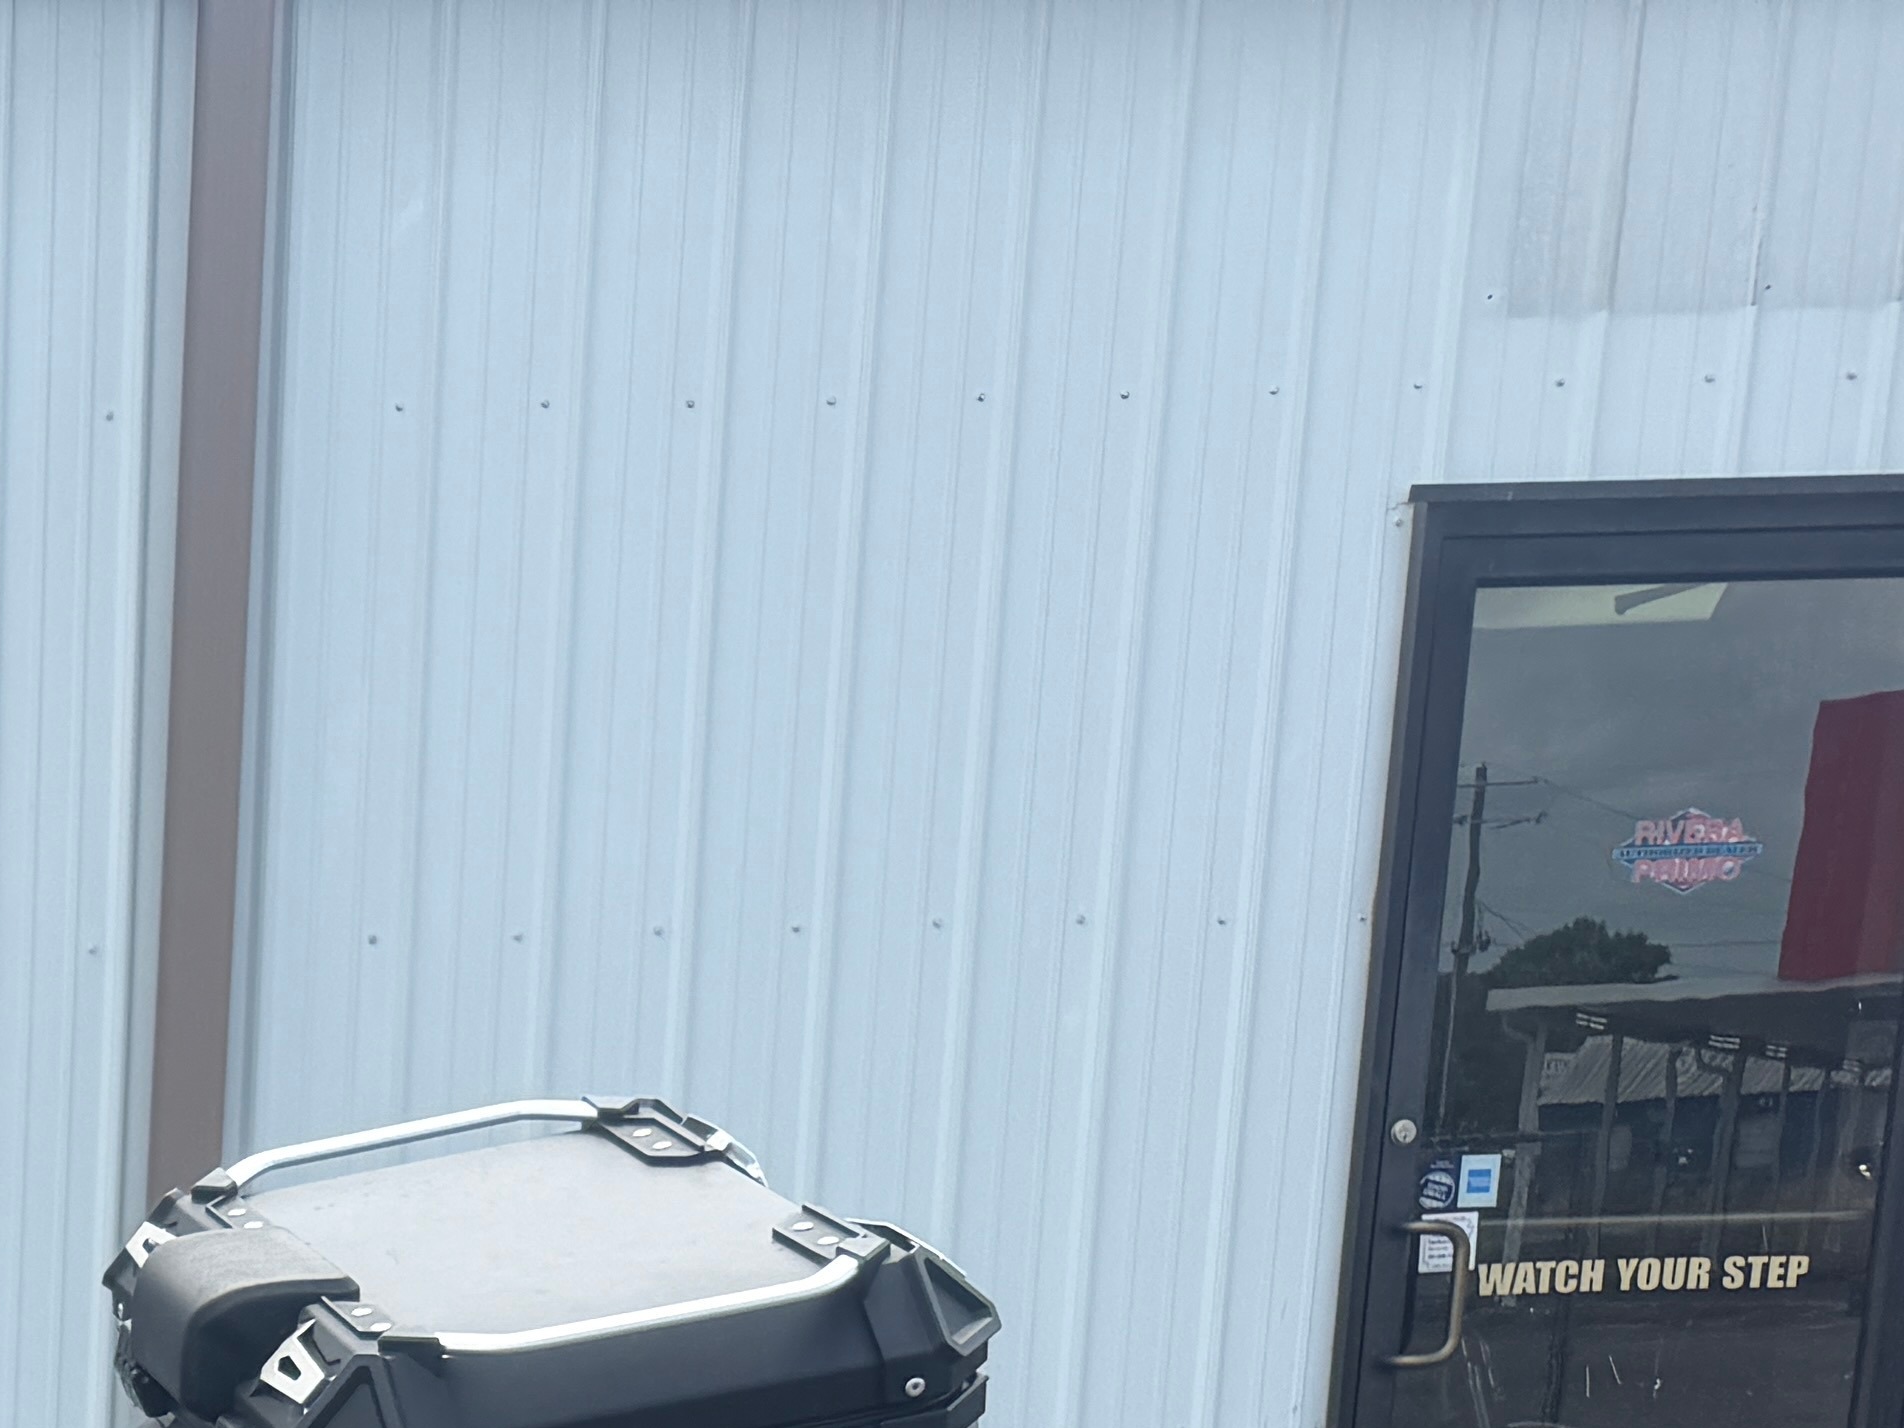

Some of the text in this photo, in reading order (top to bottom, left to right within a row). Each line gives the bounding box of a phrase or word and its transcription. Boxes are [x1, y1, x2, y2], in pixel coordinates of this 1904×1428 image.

[1478, 1254, 1810, 1296] WATCH YOUR STEP
